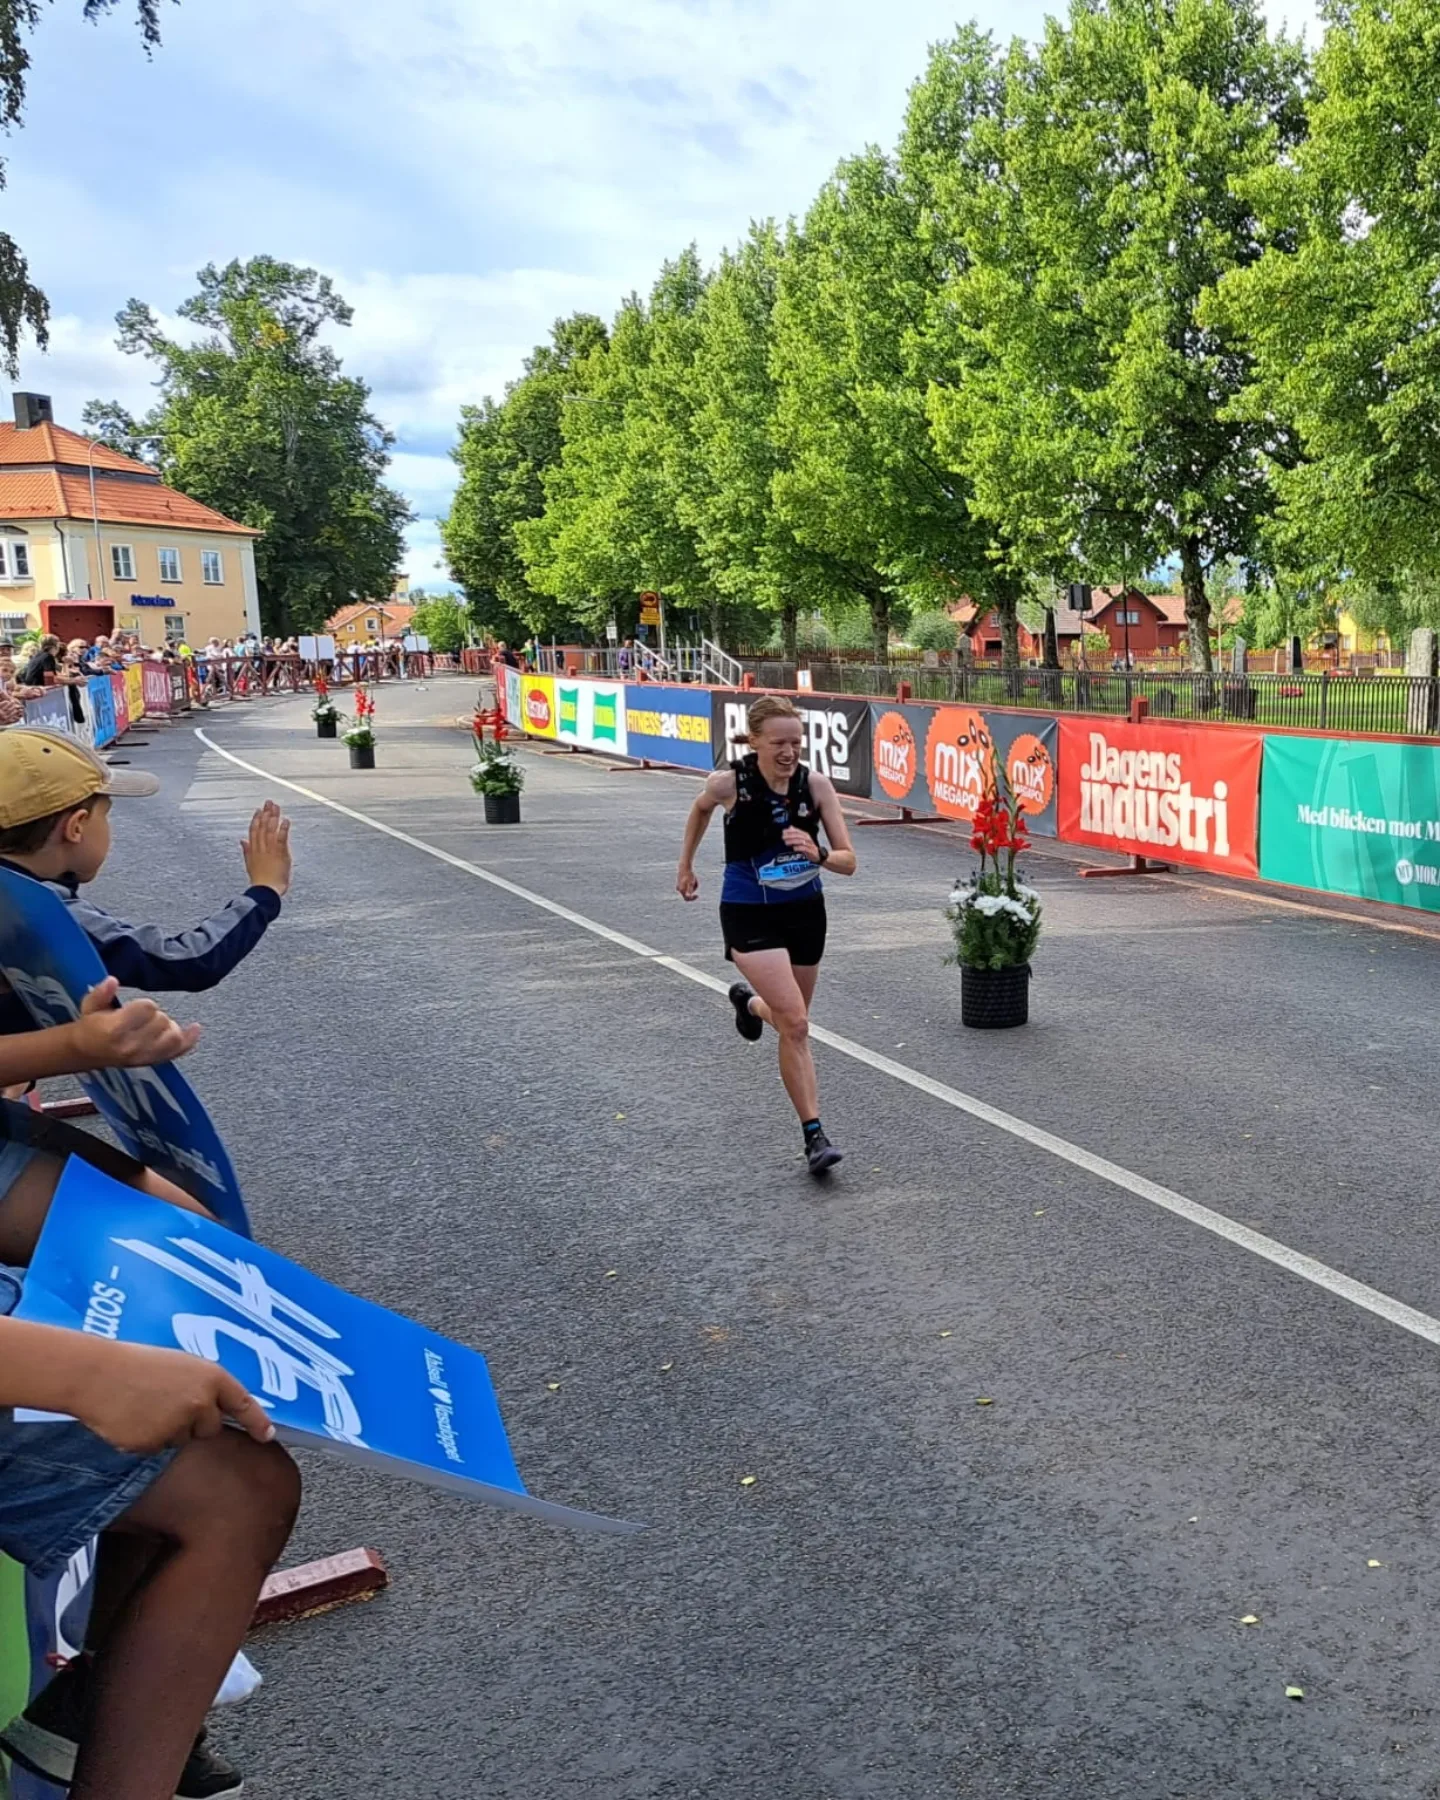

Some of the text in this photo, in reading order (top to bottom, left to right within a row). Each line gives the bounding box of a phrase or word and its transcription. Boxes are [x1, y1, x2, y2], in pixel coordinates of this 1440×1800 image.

[879, 764, 907, 786] MEGAPOL
[1089, 732, 1181, 791] Dagens
[1080, 763, 1230, 857] industri
[1297, 804, 1328, 827] Med
[1330, 807, 1386, 834] blicken
[1388, 819, 1422, 839] mot
[1414, 864, 1440, 888] MOR
